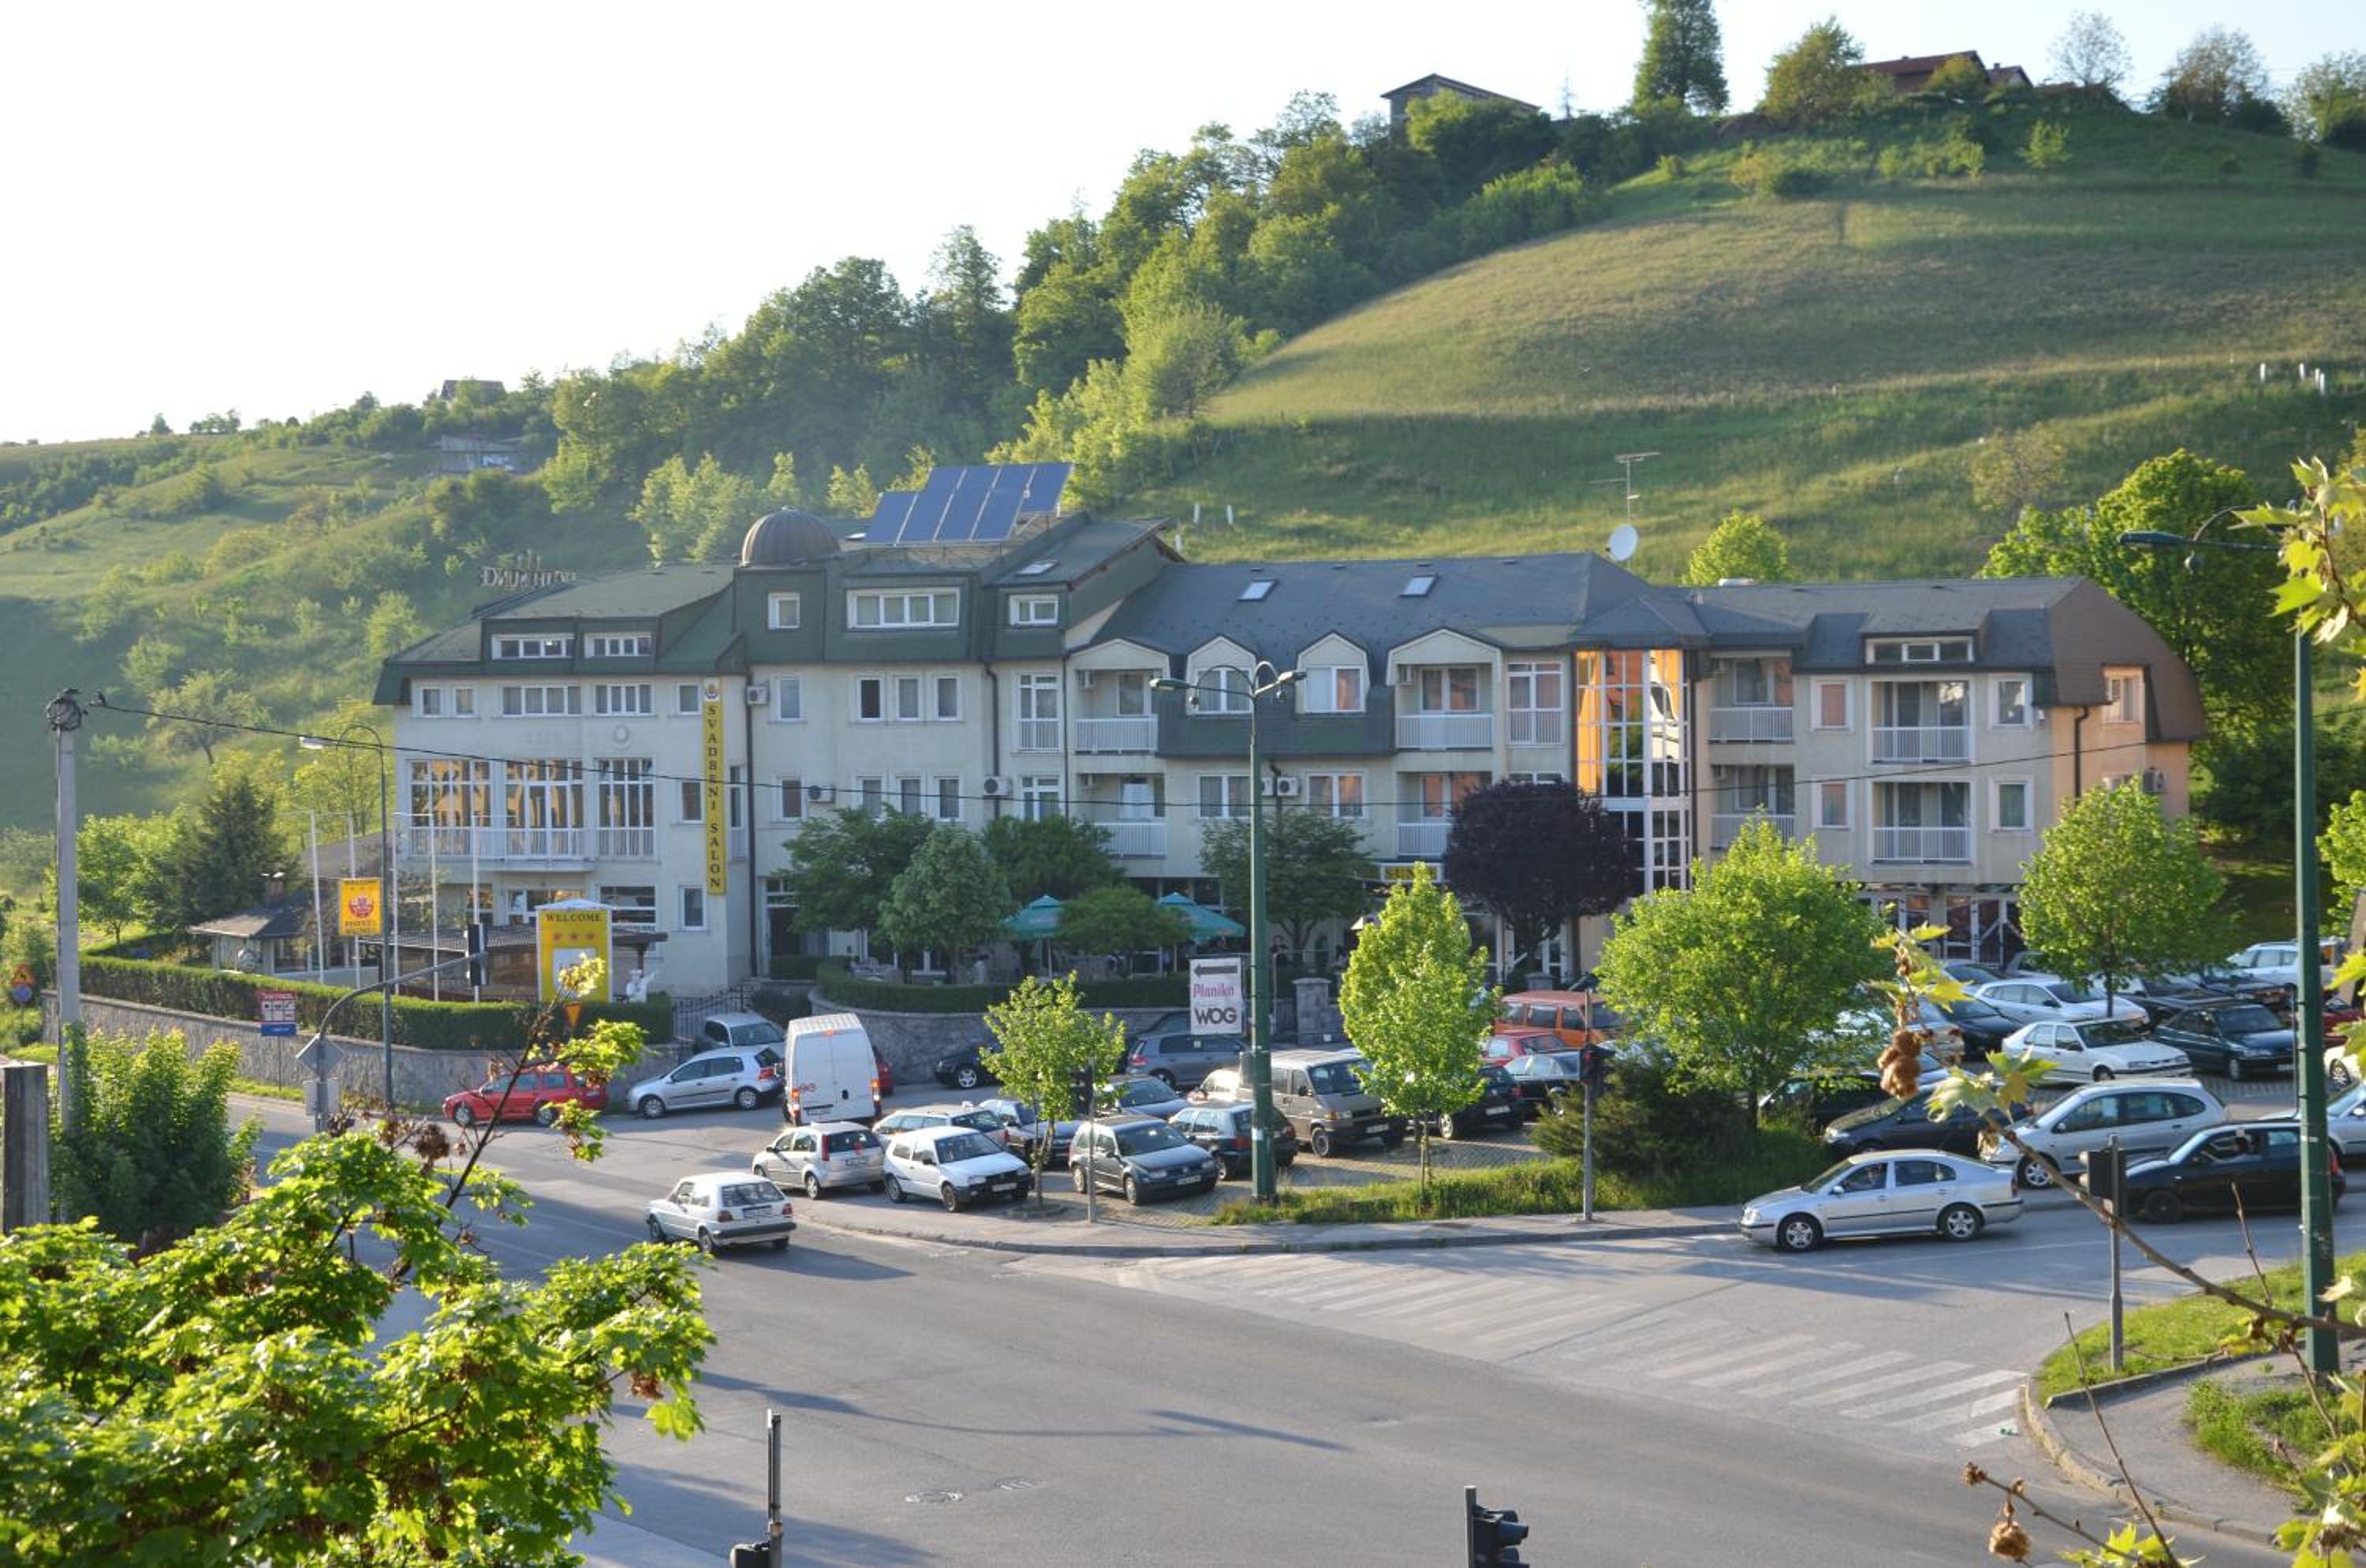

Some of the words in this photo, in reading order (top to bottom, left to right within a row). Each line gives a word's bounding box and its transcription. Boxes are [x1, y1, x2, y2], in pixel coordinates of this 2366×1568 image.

[707, 706, 718, 809] SVADBENI
[708, 823, 721, 888] SALON
[546, 913, 603, 922] WELCOME
[1194, 1006, 1238, 1025] WOG
